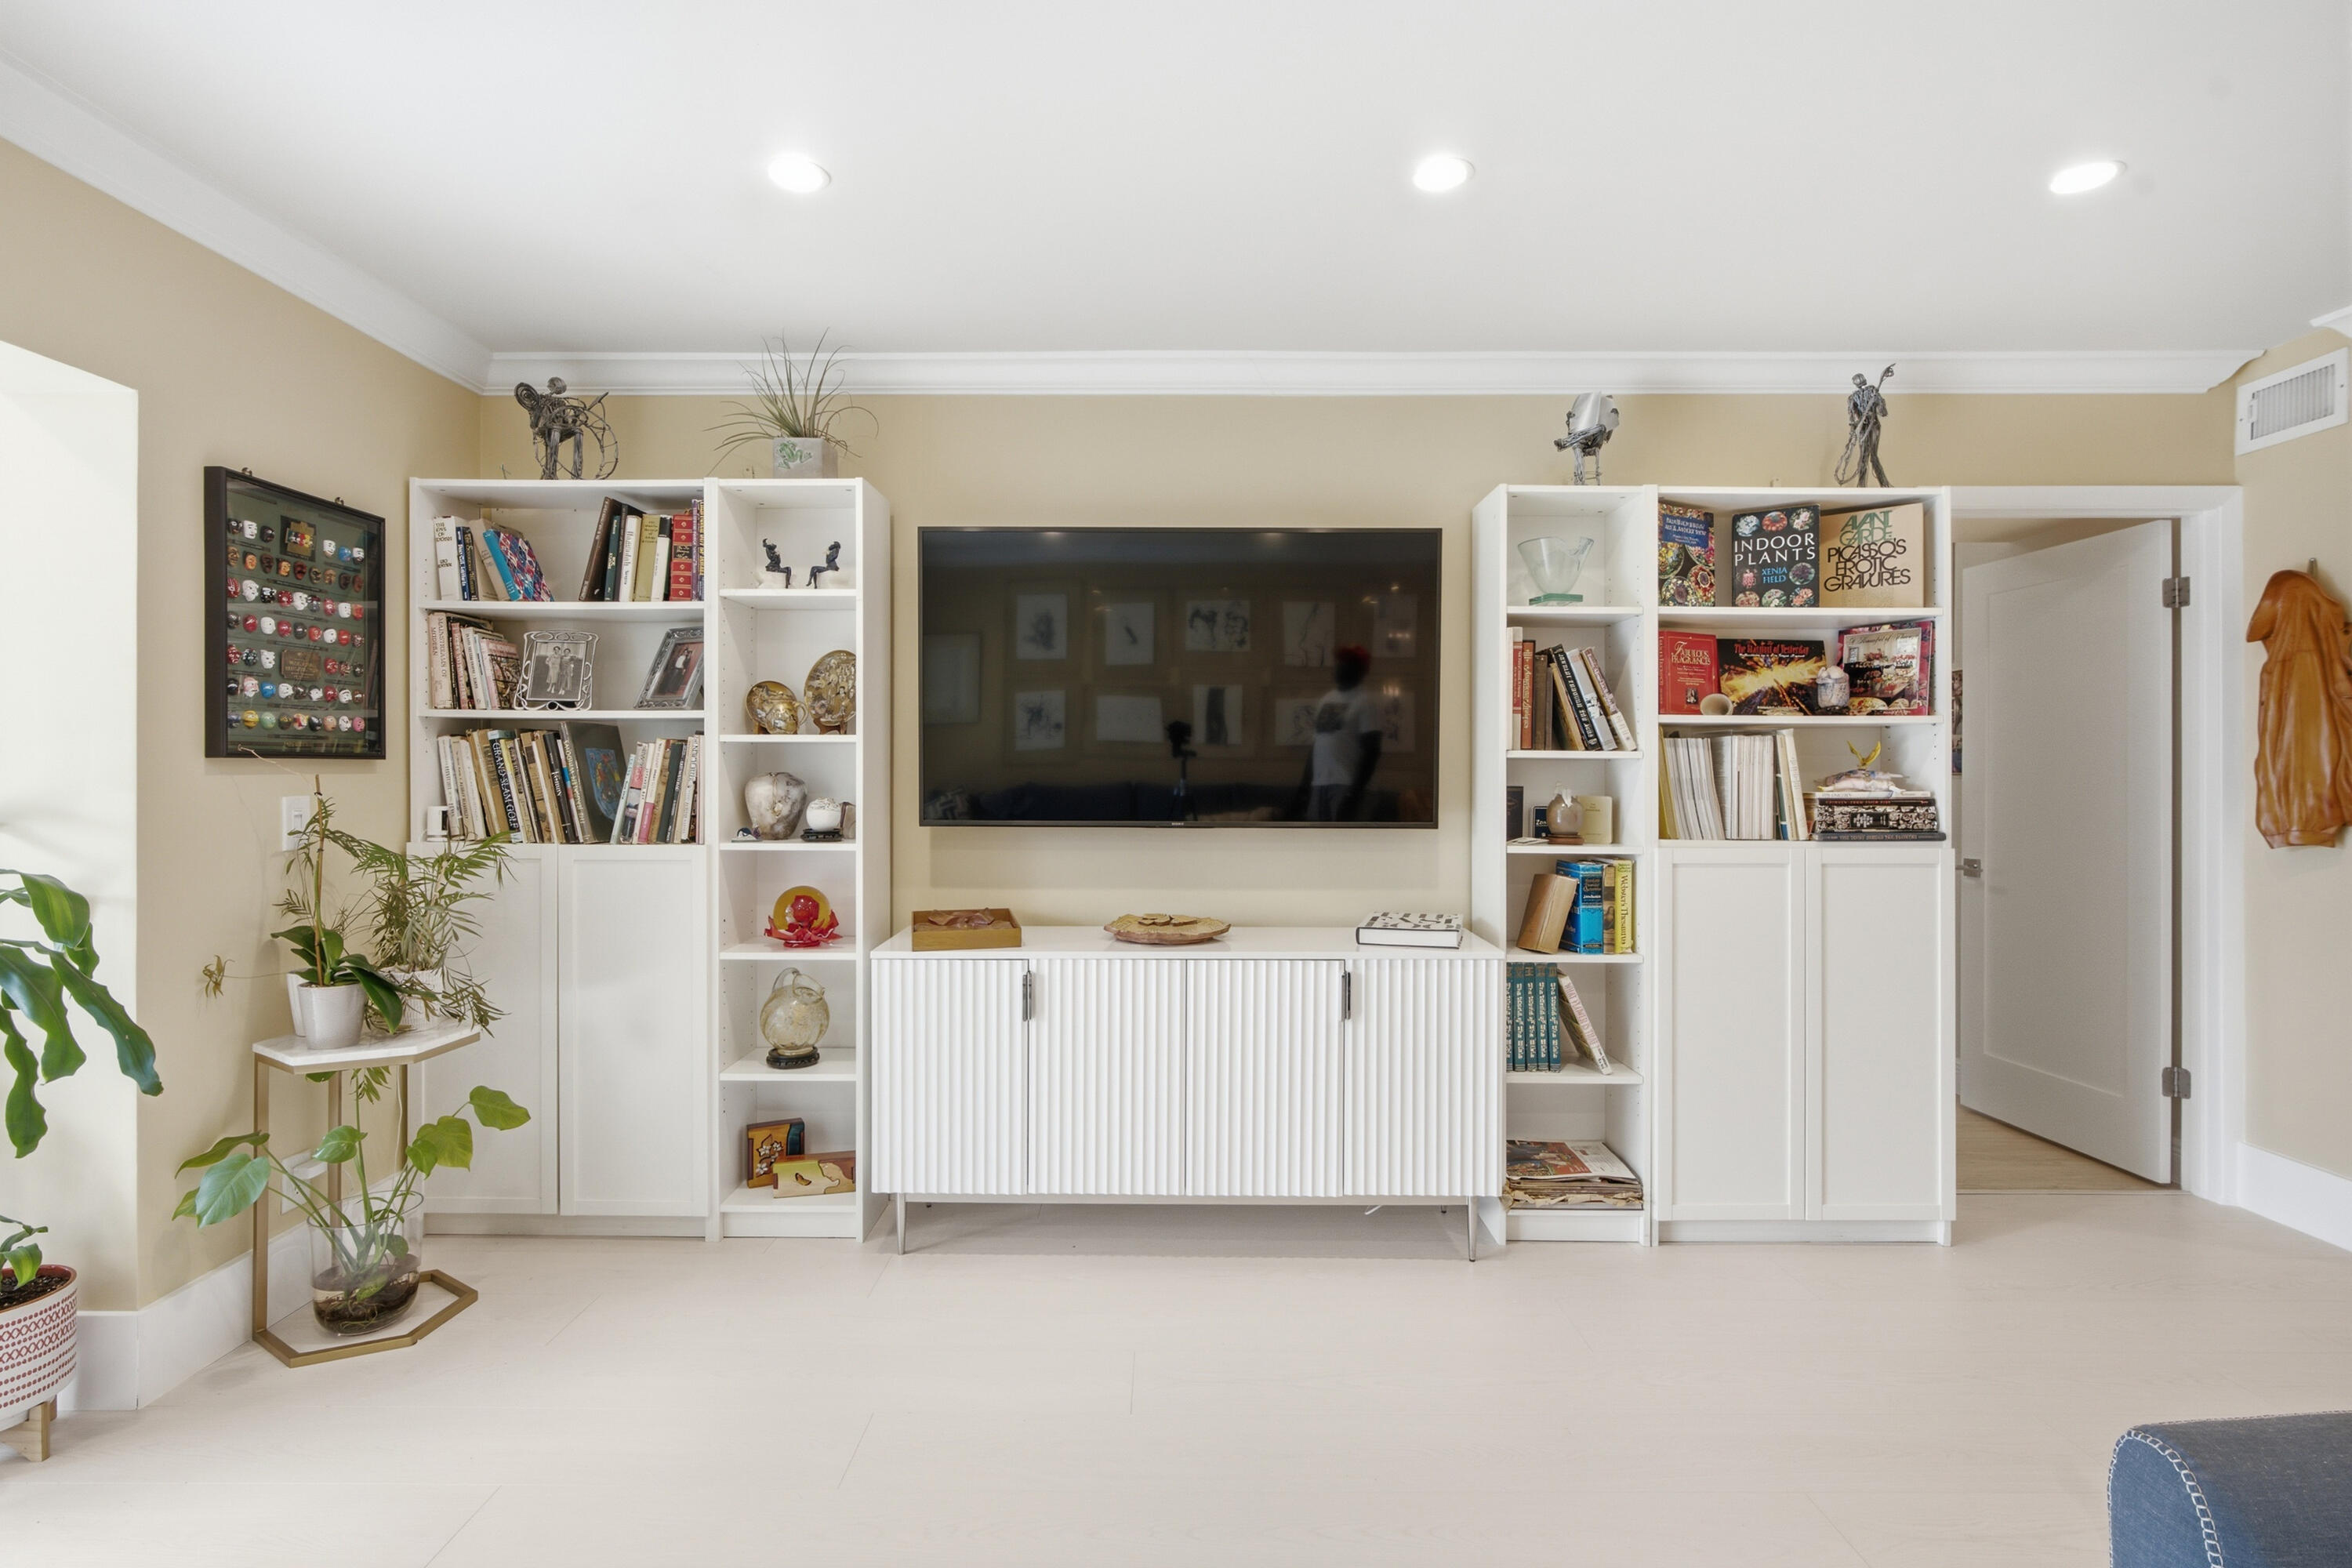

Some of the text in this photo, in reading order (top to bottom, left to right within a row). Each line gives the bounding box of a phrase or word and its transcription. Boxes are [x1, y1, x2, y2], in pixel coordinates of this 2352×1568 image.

[1840, 510, 1893, 532] AVANT
[1734, 533, 1816, 553] INDOOR
[1839, 525, 1893, 546] GARDE
[1735, 546, 1816, 566] PLANTS
[1828, 538, 1907, 563] PICASSO'S
[1835, 555, 1897, 576] EROTIC
[1824, 568, 1911, 591] GRAVURES
[506, 805, 519, 829] GOLF
